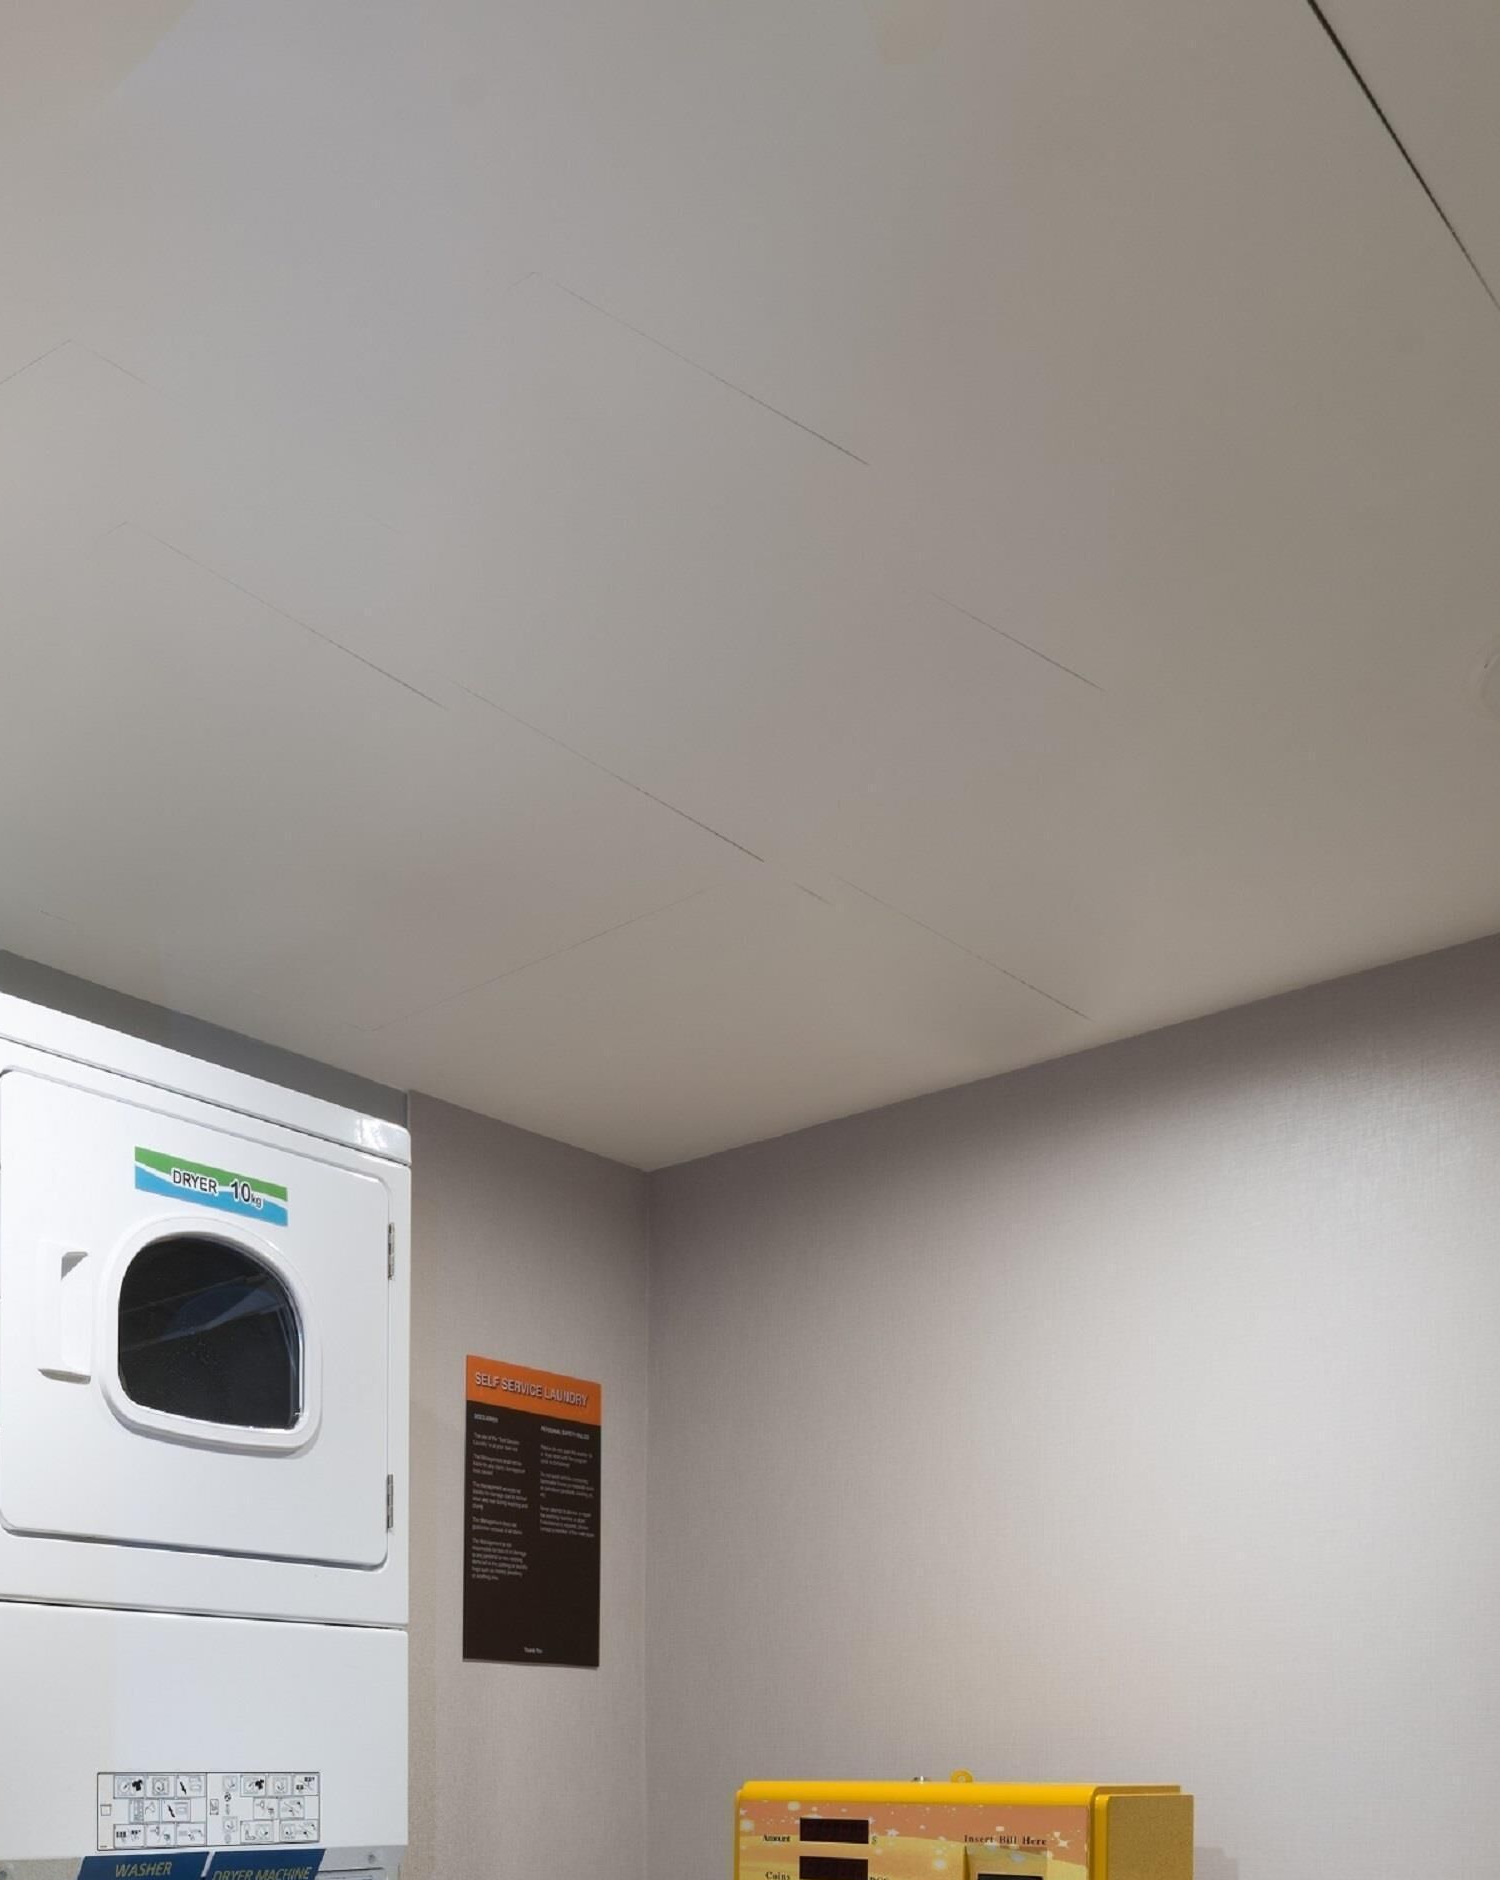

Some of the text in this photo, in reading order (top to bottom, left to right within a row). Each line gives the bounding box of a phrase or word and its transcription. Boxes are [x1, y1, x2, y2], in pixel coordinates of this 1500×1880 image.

[172, 1170, 217, 1194] DRYER
[475, 1372, 588, 1407] SELF SERVICE LAUNDRY
[964, 1835, 1046, 1846] Insert Bill Here
[115, 1861, 173, 1878] WASHER
[765, 1871, 791, 1880] Coins
